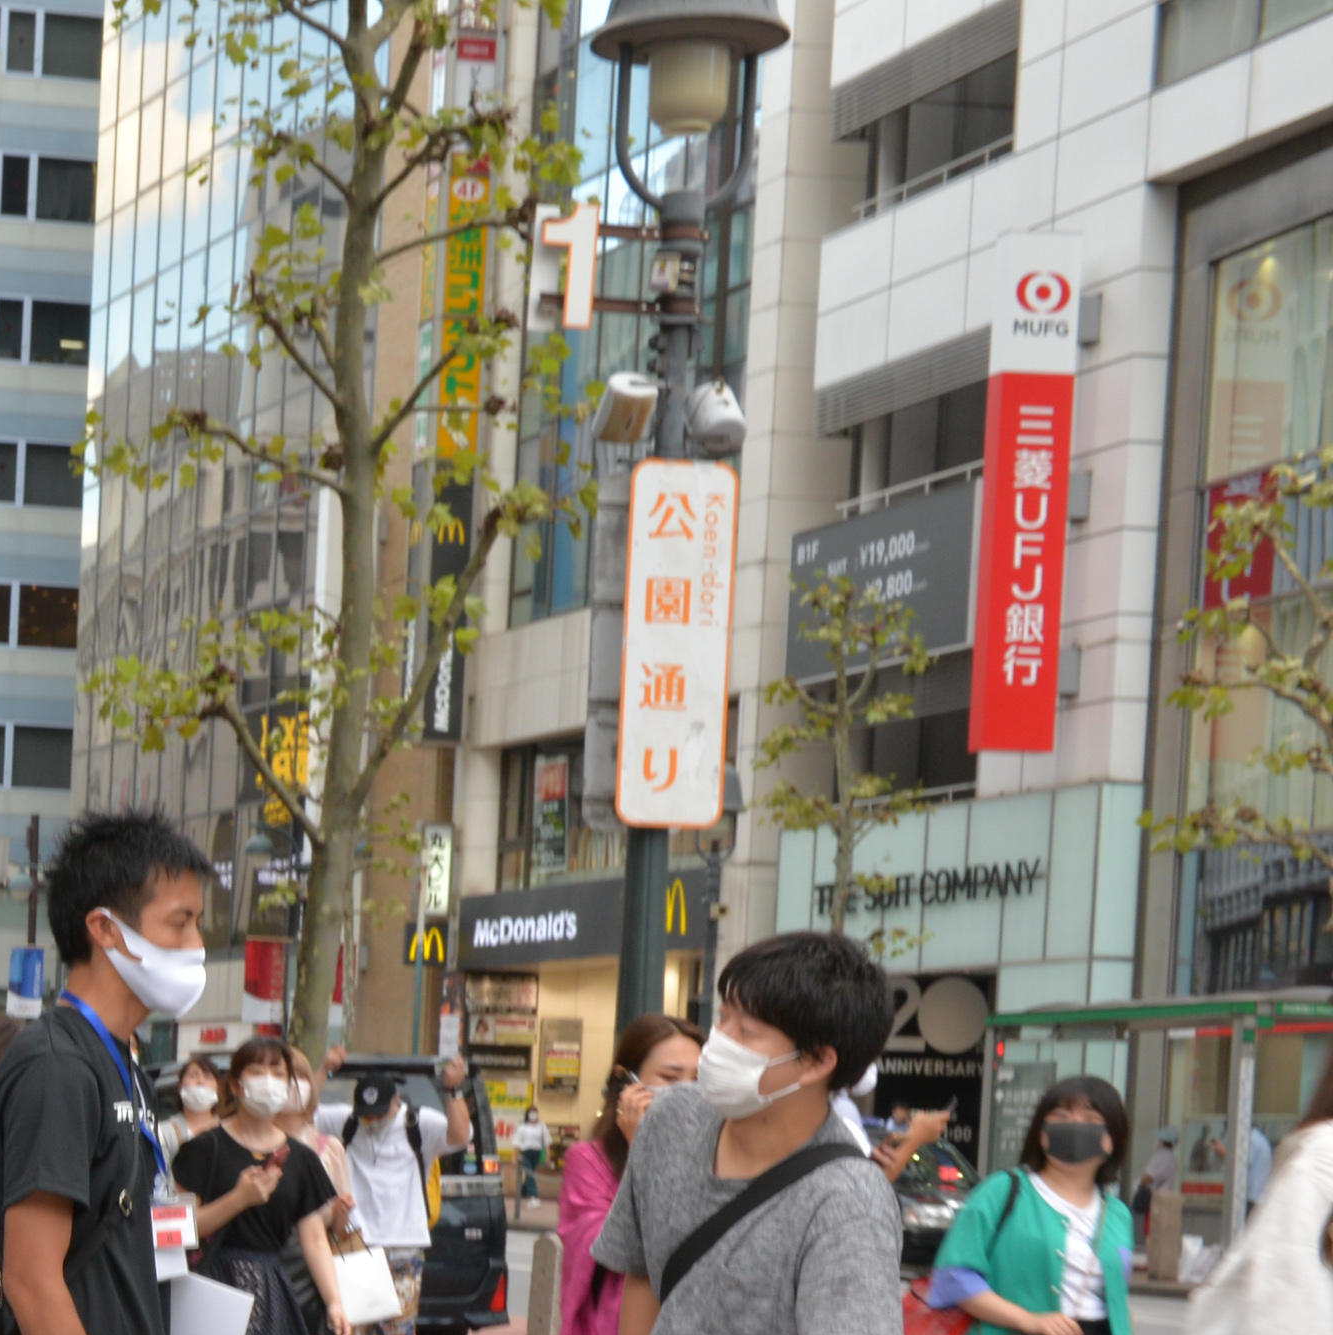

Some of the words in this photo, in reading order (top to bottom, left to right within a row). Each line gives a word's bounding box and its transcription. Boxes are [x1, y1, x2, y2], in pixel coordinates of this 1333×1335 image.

[1013, 319, 1069, 337] MUFG
[699, 492, 727, 627] Koen-dori
[796, 540, 820, 566] B1F
[859, 529, 916, 567] ¥19,000
[1003, 404, 1055, 687] 三菱UFJ銀行
[638, 491, 697, 793] 公園通り
[919, 856, 1042, 906] COMPANY
[472, 909, 578, 949] McDonald's
